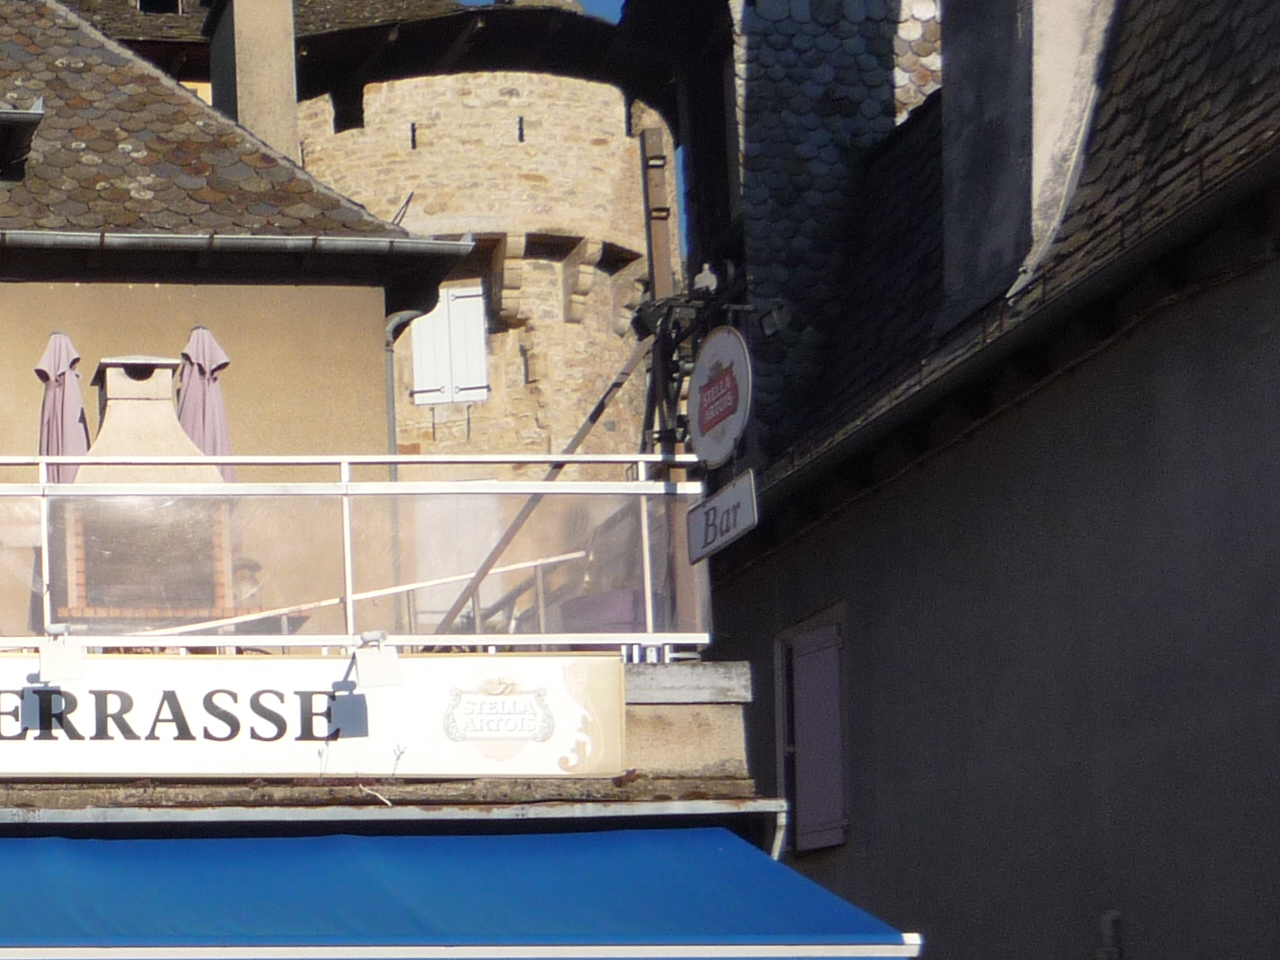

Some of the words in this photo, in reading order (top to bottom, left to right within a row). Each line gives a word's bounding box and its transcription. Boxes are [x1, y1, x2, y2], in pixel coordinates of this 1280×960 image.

[703, 377, 731, 406] STELLA
[704, 396, 734, 422] ARTOIS
[701, 500, 741, 549] Bar
[463, 700, 537, 715] STELLA
[462, 716, 536, 732] ARTOIS
